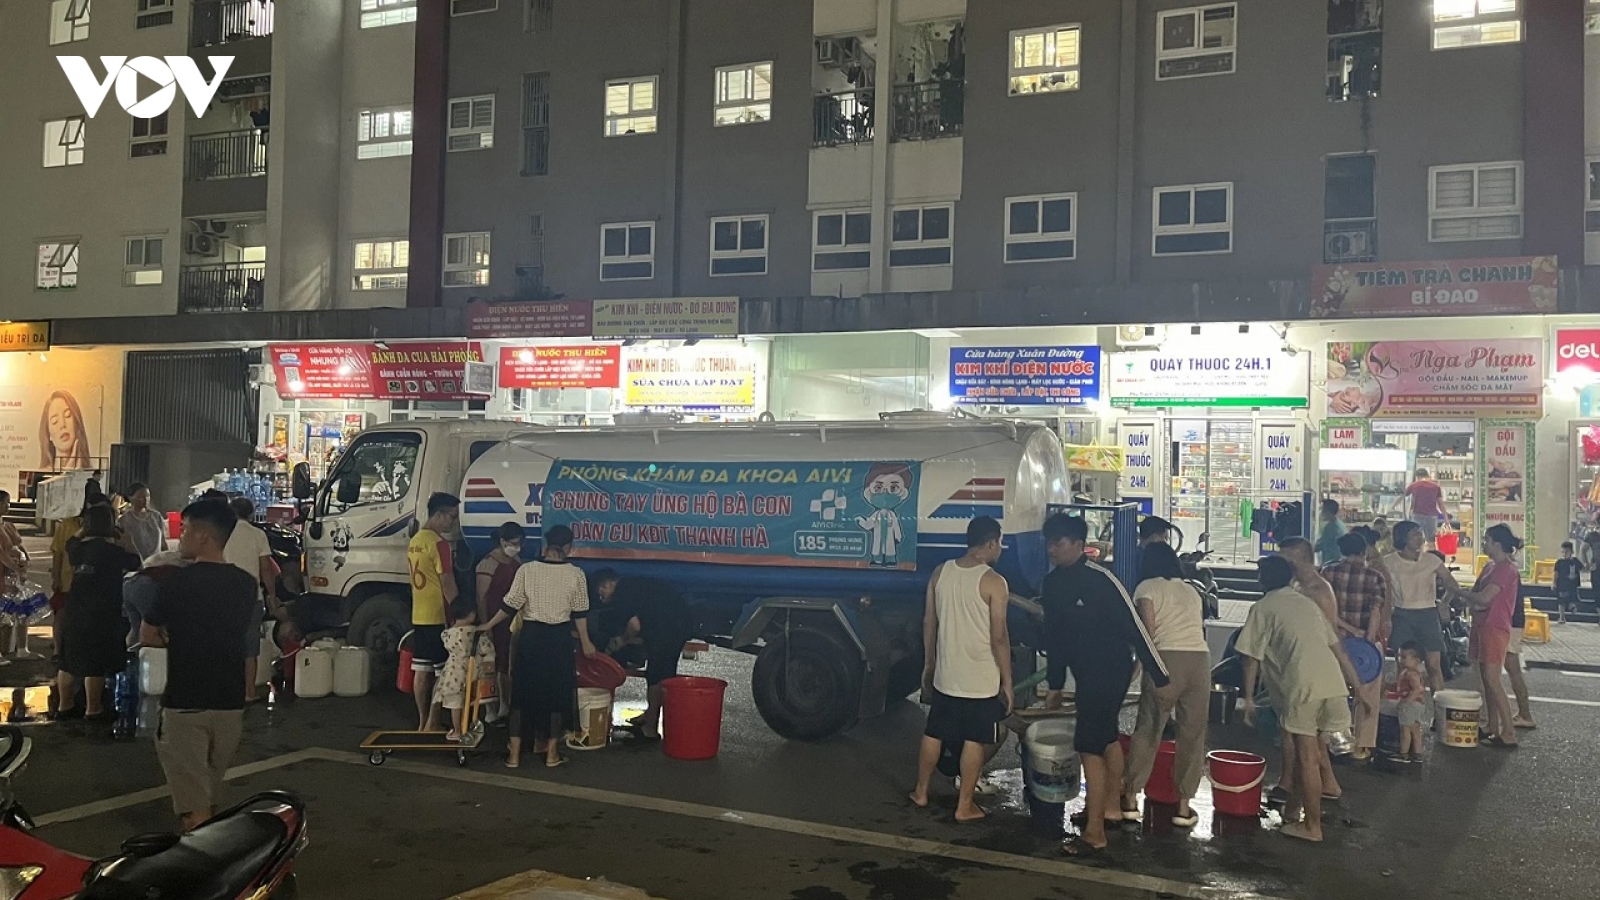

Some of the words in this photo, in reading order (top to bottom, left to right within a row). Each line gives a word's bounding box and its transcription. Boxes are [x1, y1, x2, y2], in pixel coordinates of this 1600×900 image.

[1413, 263, 1452, 284] TRÀ
[1458, 264, 1533, 283] CHANH
[1434, 289, 1479, 304] ĐAO
[702, 302, 714, 314] GIA
[410, 351, 430, 363] CUA
[627, 358, 643, 372] KIM
[1410, 348, 1462, 373] Nga
[1464, 346, 1535, 374] Phạm
[955, 362, 981, 375] KIM
[1012, 360, 1046, 378] ĐIỆN
[1050, 360, 1094, 375] NƯỚC
[558, 464, 629, 482] PHÒNG
[633, 465, 695, 483] KHÁM
[700, 468, 728, 483] ĐA
[736, 468, 798, 484] KHOA
[525, 483, 545, 506] X
[553, 490, 610, 511] CHUNG
[614, 492, 649, 512] TAY
[692, 490, 718, 518] HỘ
[723, 491, 749, 516] BÀ
[752, 495, 792, 516] CON
[570, 519, 605, 542] DÂN
[638, 525, 670, 545] KĐT
[675, 526, 736, 548] THANH
[741, 524, 769, 549] HÀ
[798, 535, 826, 551] 185
